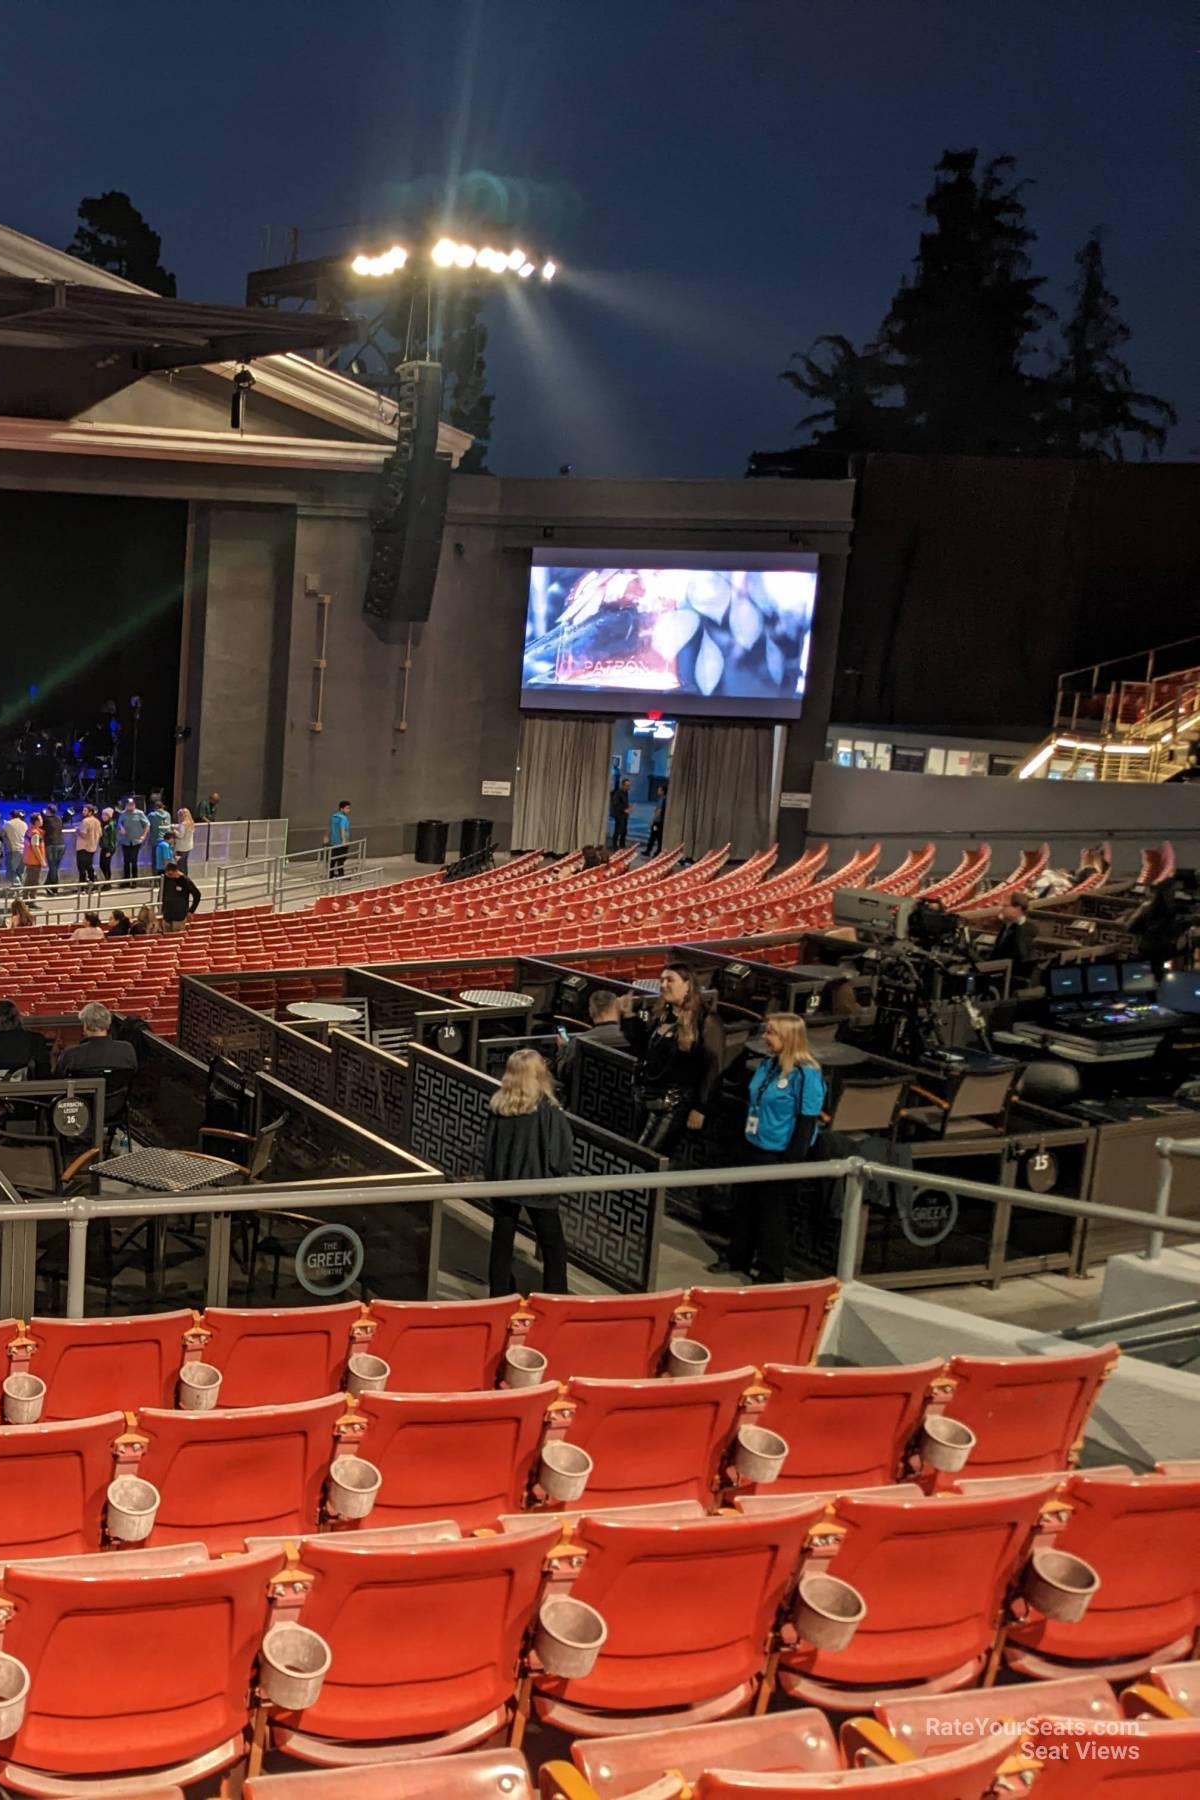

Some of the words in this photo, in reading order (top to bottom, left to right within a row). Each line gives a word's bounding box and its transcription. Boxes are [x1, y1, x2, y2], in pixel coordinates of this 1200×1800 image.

[583, 655, 648, 674] PATRÓN
[443, 1026, 456, 1038] 14
[67, 1115, 76, 1124] 16
[1034, 1155, 1049, 1170] 15
[323, 1242, 337, 1250] THE
[306, 1251, 352, 1268] GREEK
